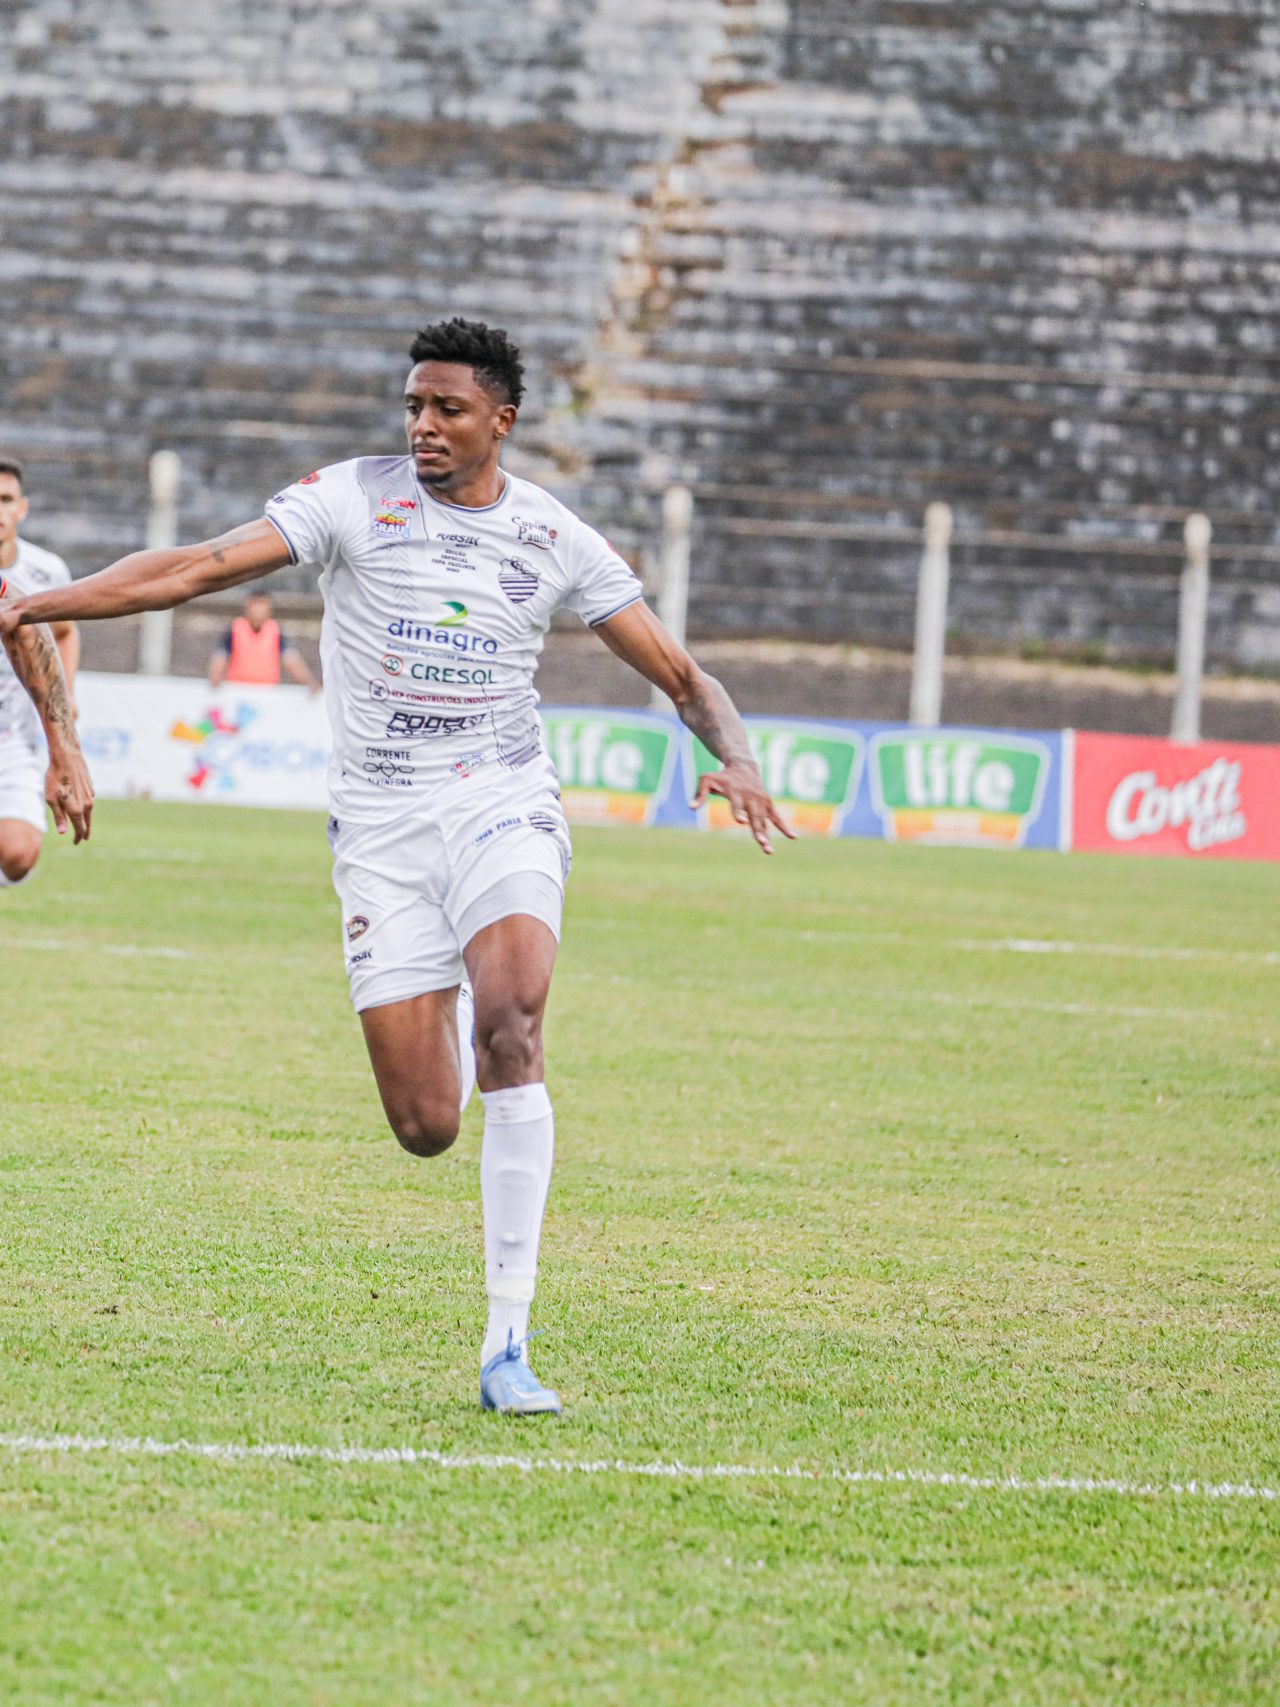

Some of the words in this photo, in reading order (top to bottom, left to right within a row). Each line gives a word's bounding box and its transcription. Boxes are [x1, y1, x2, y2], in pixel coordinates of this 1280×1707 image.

[388, 618, 498, 654] dinagro
[410, 663, 499, 685] CRESOL
[365, 747, 411, 761] CORRENTE
[903, 742, 1015, 811] life
[1106, 756, 1241, 841] Conti
